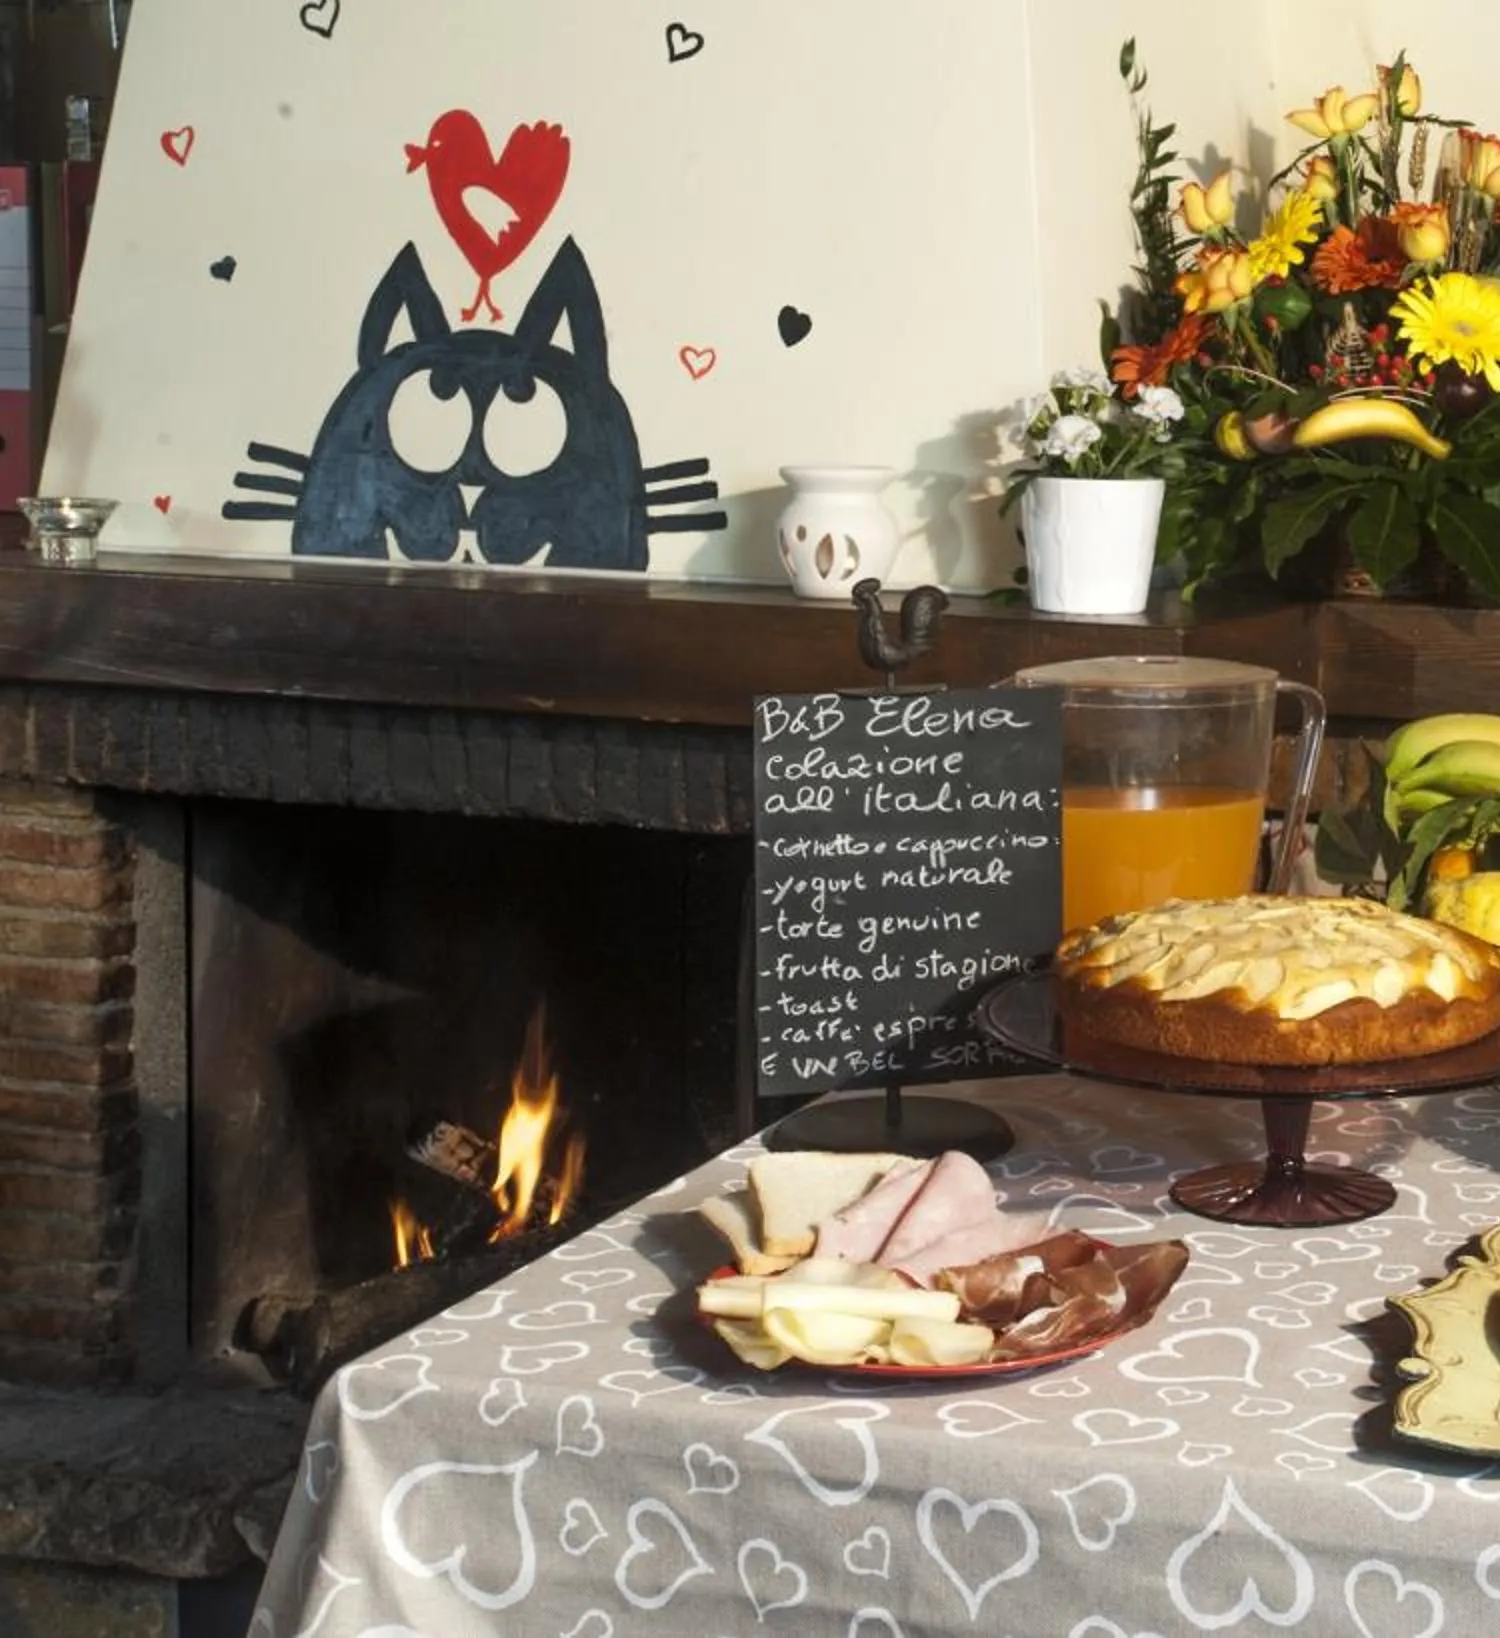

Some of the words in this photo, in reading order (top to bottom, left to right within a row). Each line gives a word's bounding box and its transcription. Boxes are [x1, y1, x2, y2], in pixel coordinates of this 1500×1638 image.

[755, 693, 845, 743] B&B
[865, 696, 1032, 737] Elena
[881, 857, 1014, 888] naturale
[857, 905, 983, 953] genuine
[871, 953, 905, 983] di
[843, 1050, 905, 1075] BEL
